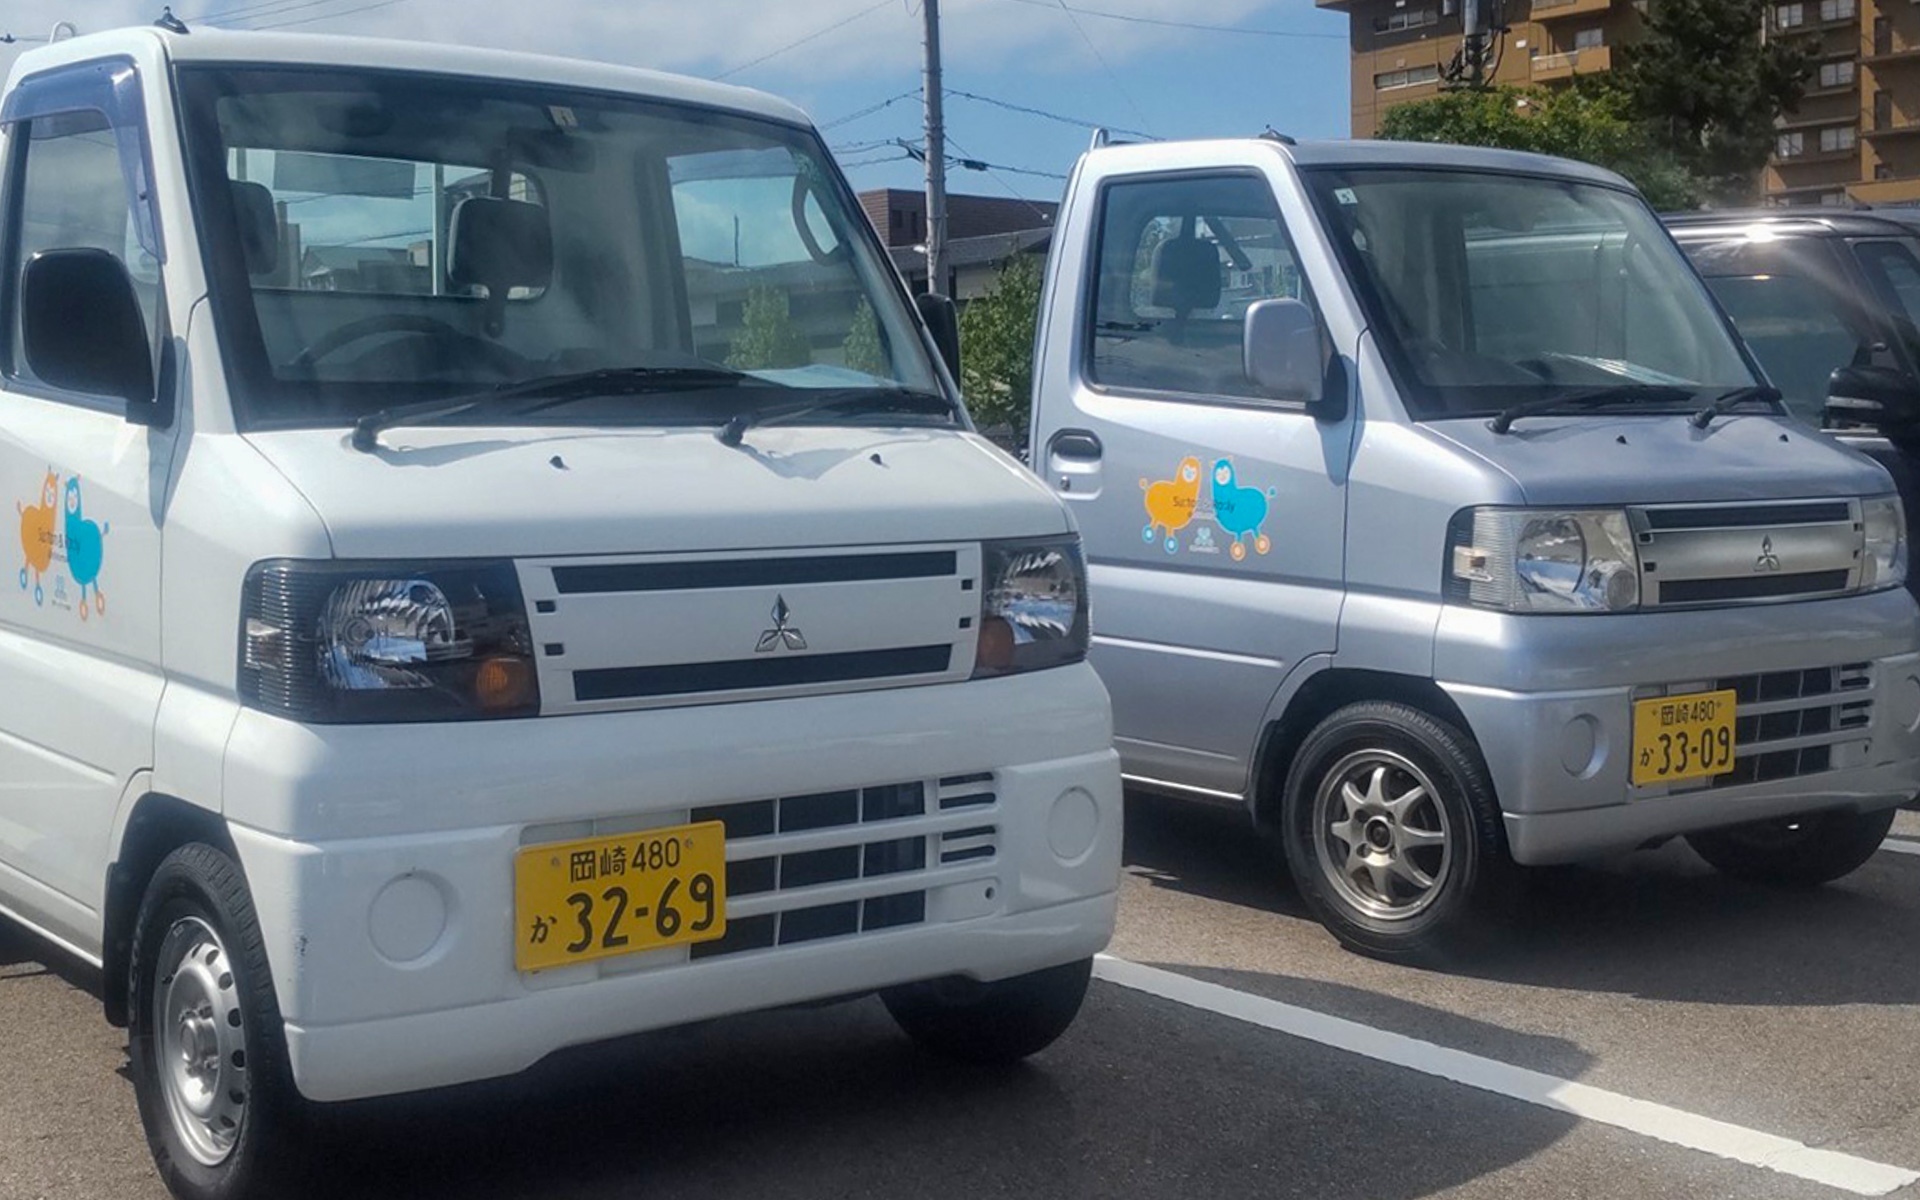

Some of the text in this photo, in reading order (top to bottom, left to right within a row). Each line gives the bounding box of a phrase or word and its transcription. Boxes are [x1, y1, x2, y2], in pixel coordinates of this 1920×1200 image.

[1690, 700, 1715, 722] 480
[1640, 725, 1731, 775] か 33-09
[570, 837, 681, 883] 岡崎 480
[530, 872, 715, 953] か 32-69
